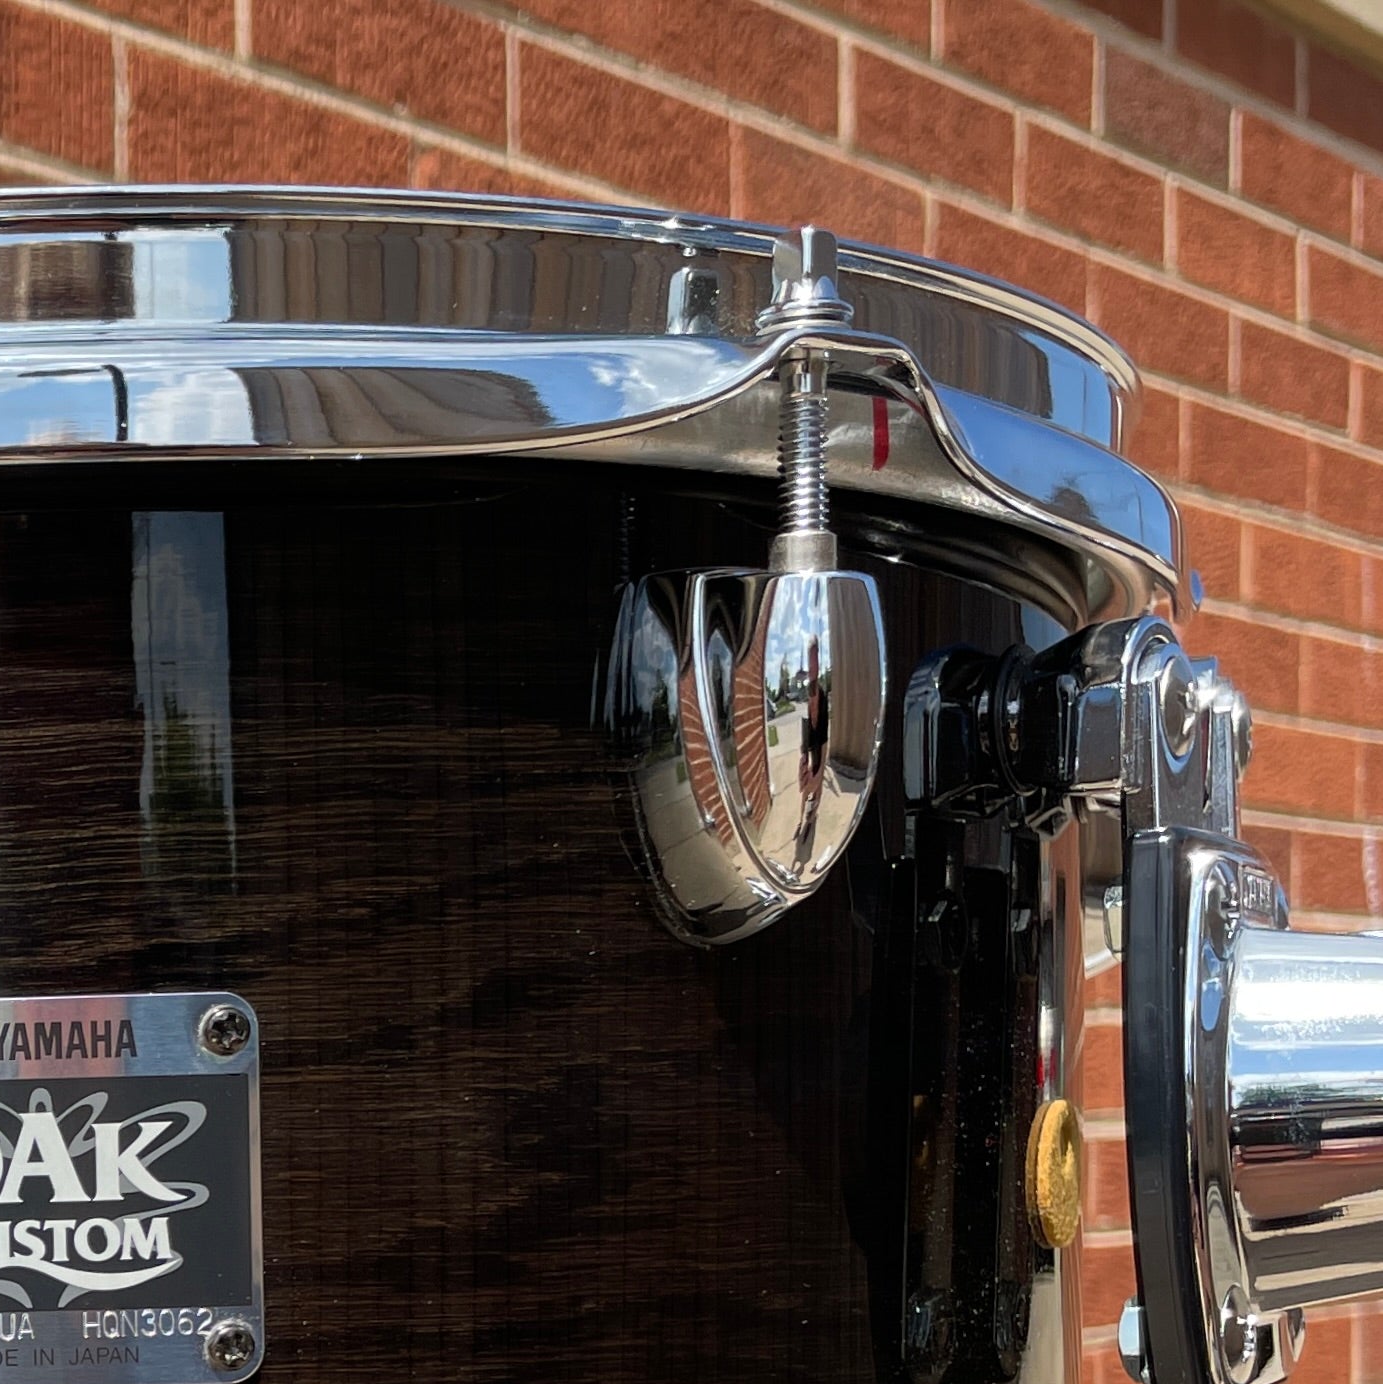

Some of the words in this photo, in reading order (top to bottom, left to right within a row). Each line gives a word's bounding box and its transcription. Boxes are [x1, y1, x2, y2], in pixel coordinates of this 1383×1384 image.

[82, 1308, 215, 1339] HQN3062
[34, 1347, 55, 1366] IN
[68, 1345, 140, 1367] JAPAN
